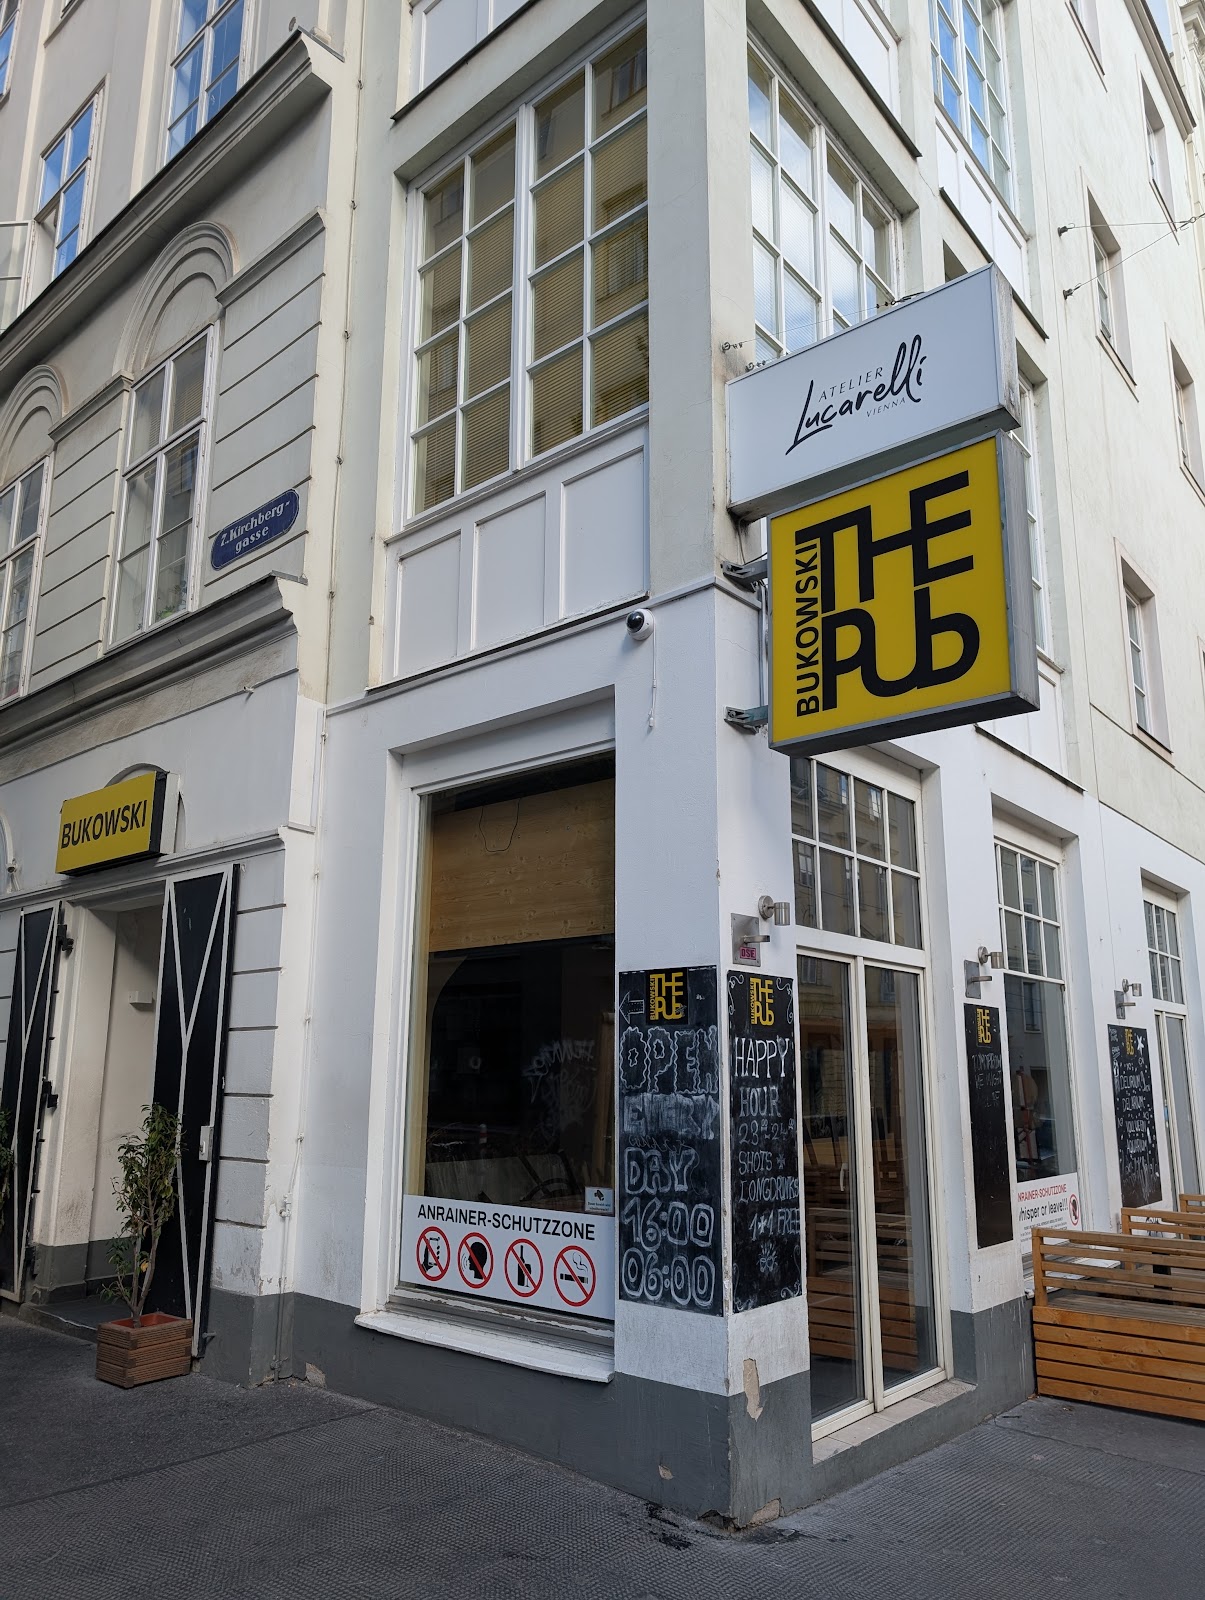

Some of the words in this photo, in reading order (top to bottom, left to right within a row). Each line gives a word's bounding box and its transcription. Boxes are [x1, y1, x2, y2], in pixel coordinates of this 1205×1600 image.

[785, 334, 927, 455] Lucarelli
[818, 366, 883, 402] ATELIER
[866, 397, 906, 418] VIENNA
[235, 526, 269, 554] gasse
[795, 469, 974, 614] THE
[795, 542, 820, 717] BUKOWSKI
[61, 799, 148, 849] BUKOWSKI
[650, 972, 684, 997] THE
[750, 977, 774, 1003] THE
[619, 1025, 719, 1094] OPEN
[734, 1036, 790, 1079] HAPPY
[739, 1085, 782, 1118] HOUR
[624, 1146, 696, 1195] DAY
[738, 1151, 773, 1175] SHOTS
[739, 1175, 799, 1204] LONGDRINKS
[417, 1204, 595, 1241] ANRAINER-SCHUTZZONE
[621, 1196, 715, 1252] 16:00
[777, 1206, 801, 1236] FREE
[1040, 1205, 1047, 1216] or
[622, 1247, 716, 1307] 06:00
